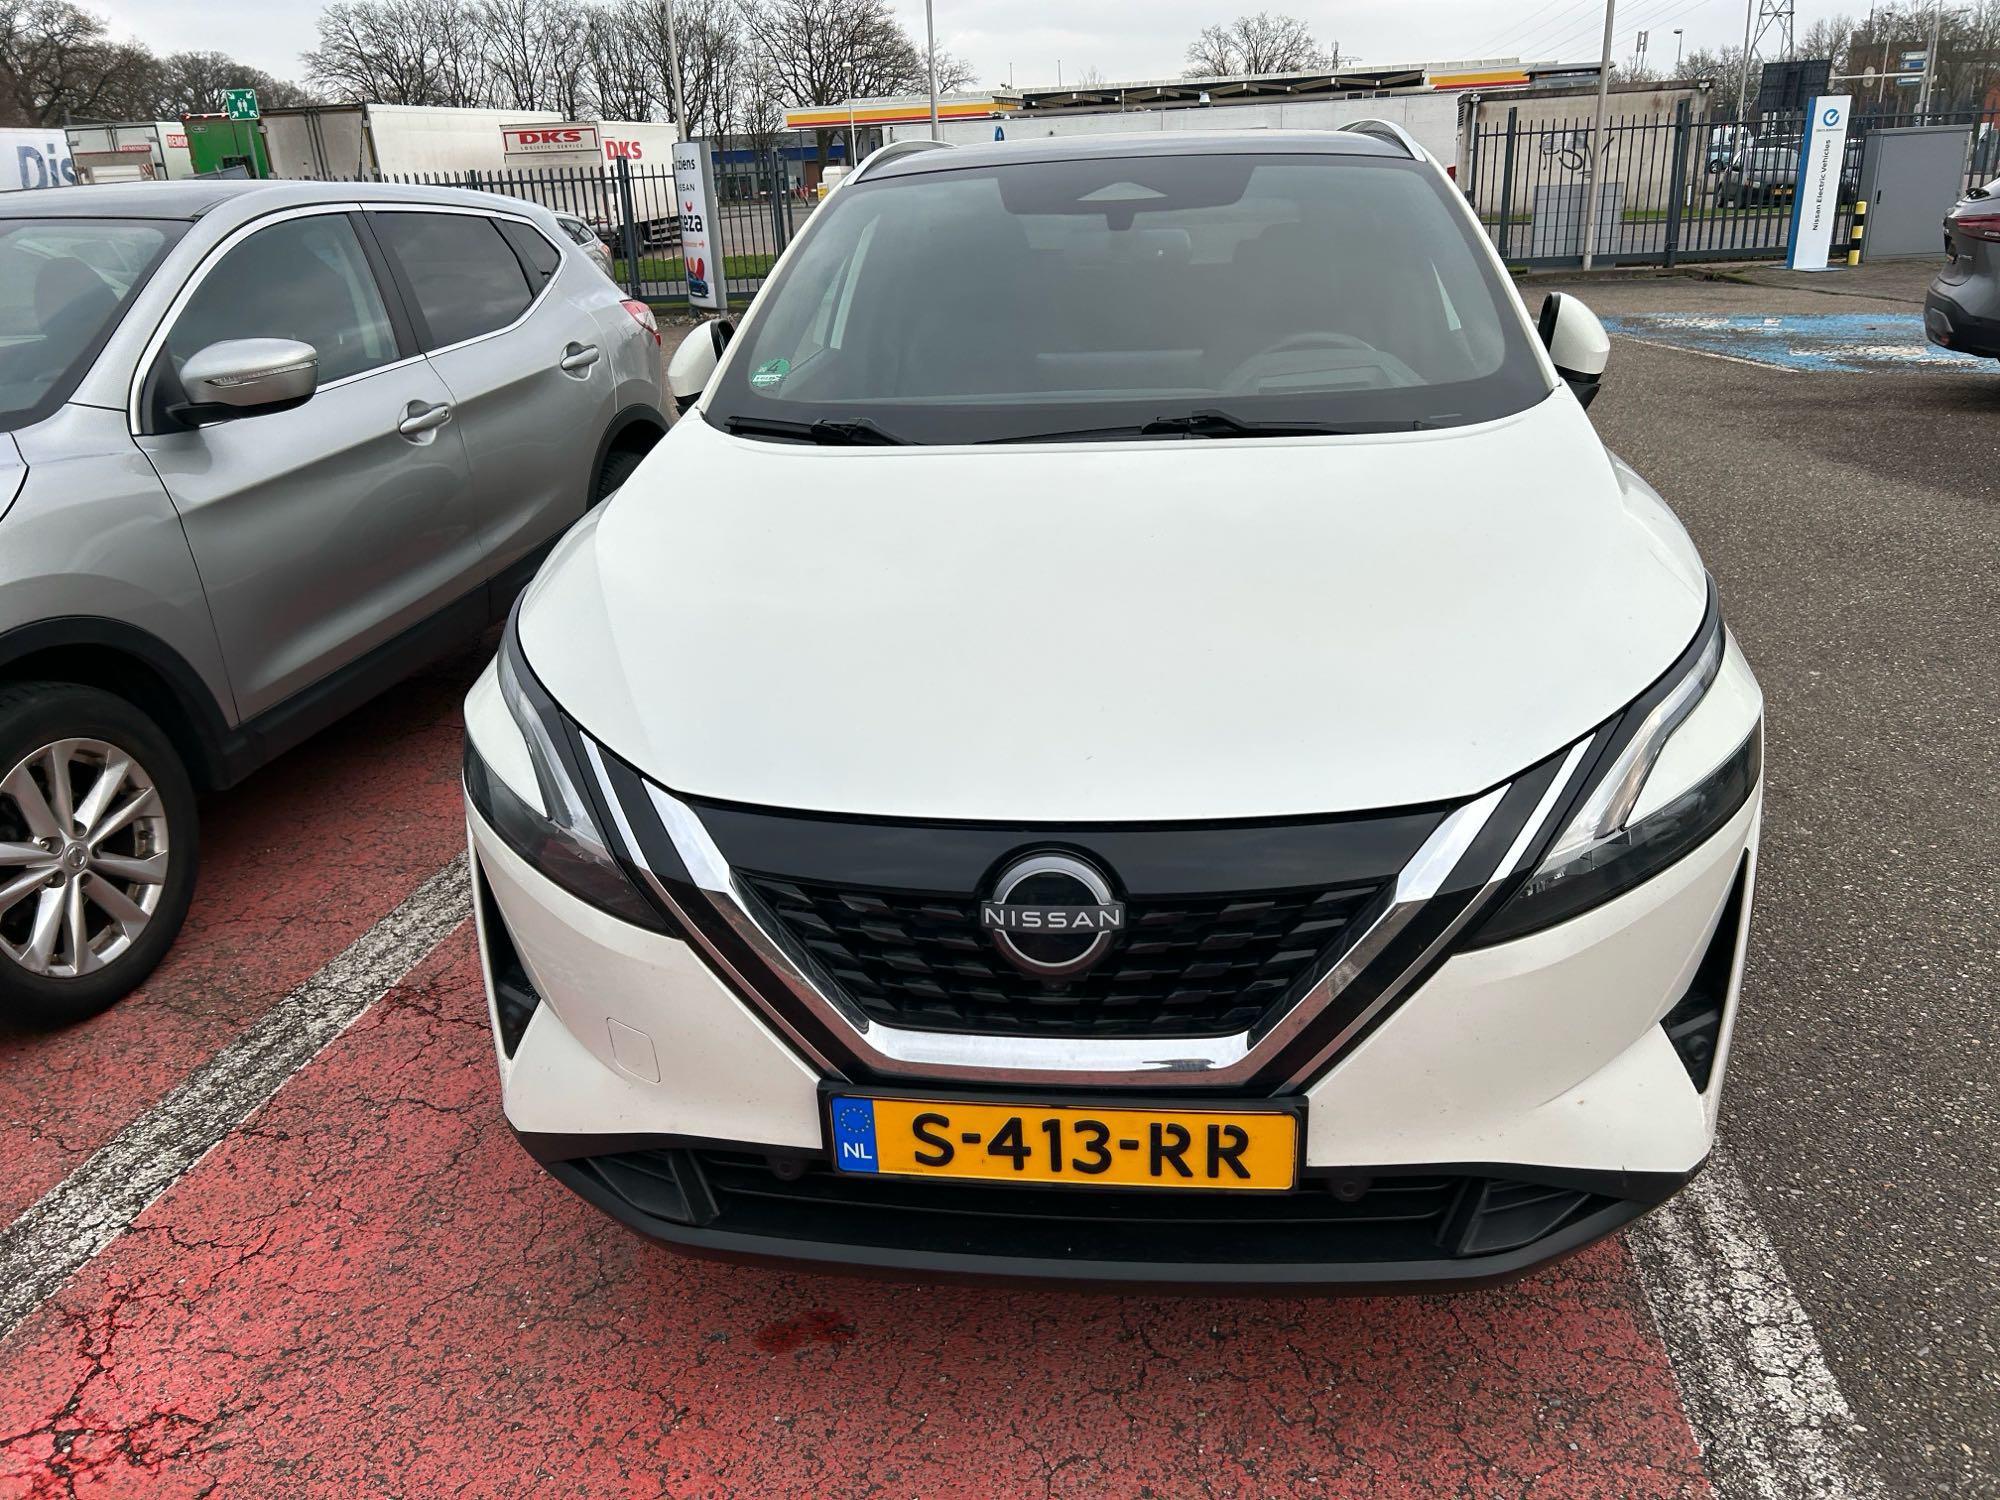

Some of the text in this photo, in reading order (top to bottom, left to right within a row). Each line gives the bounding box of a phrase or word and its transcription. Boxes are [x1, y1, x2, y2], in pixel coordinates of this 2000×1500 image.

[519, 131, 582, 144] DKS
[605, 140, 642, 160] DKS
[1813, 139, 1831, 231] Nissan Electric Vehicles
[985, 907, 1120, 928] NISSAN
[843, 1112, 1251, 1179] NL S-413-RR
